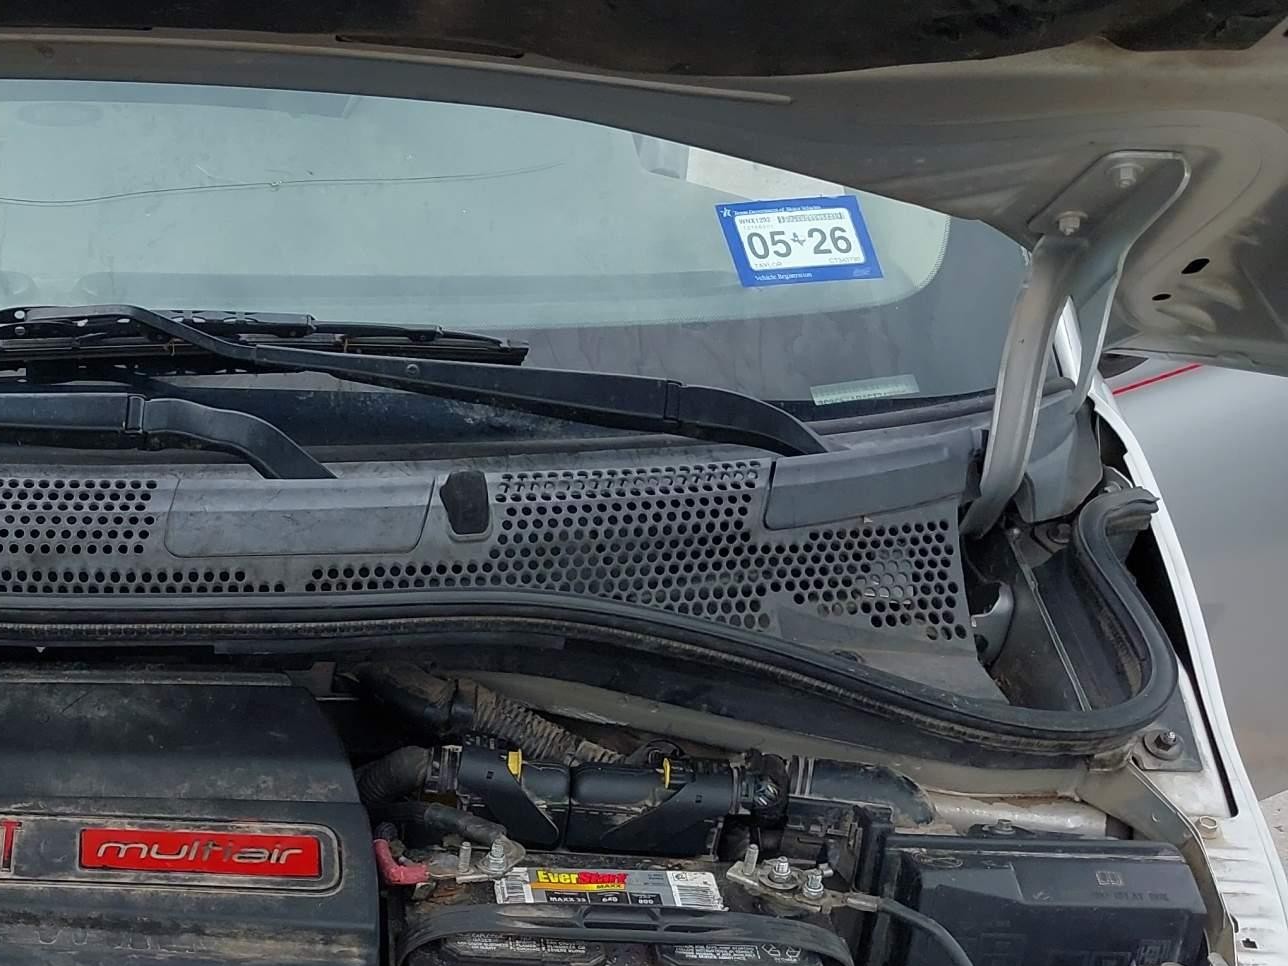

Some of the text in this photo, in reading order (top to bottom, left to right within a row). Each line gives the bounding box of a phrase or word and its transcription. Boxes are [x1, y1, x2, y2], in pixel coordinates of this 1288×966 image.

[746, 226, 852, 260] 05 26
[536, 869, 628, 885] EverStart
